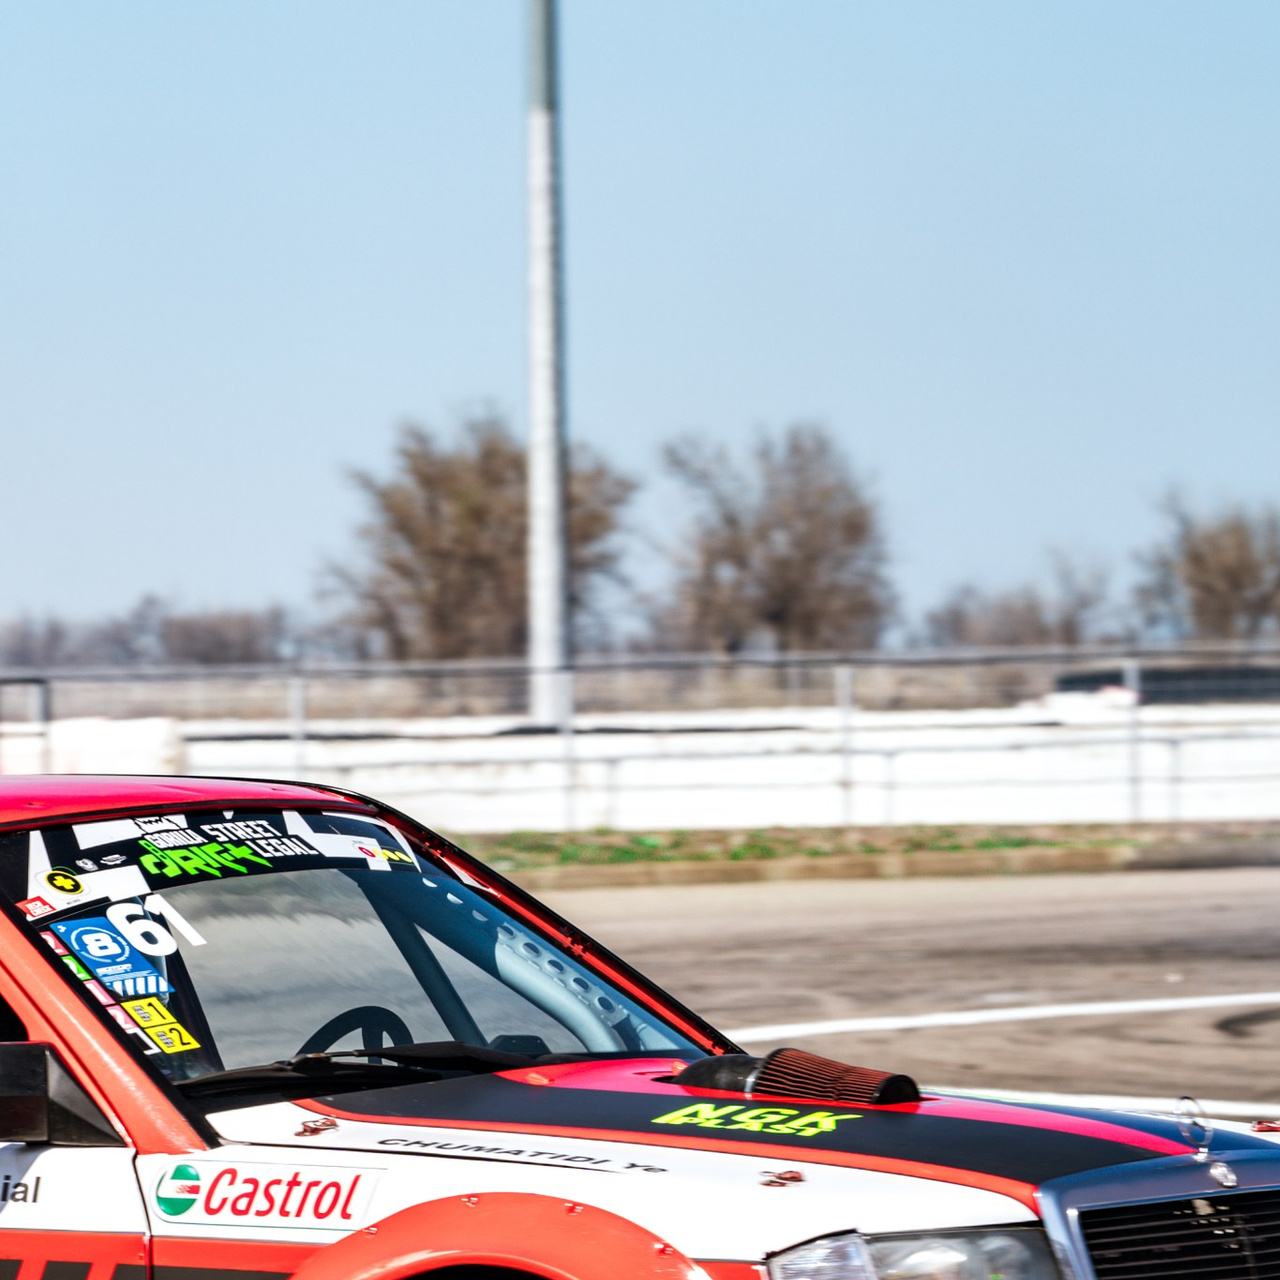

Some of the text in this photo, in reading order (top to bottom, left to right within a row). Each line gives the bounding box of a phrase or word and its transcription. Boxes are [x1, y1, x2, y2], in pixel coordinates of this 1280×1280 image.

[144, 829, 209, 849] GORILLA
[200, 820, 282, 842] STREET
[245, 838, 320, 858] LEGAL
[106, 893, 208, 956] 61
[81, 932, 122, 957] 8
[147, 1002, 167, 1020] 1
[169, 1027, 192, 1046] 2
[651, 1103, 864, 1131] NGK
[667, 1116, 835, 1137] PLAST
[204, 1167, 362, 1220] Castrol
